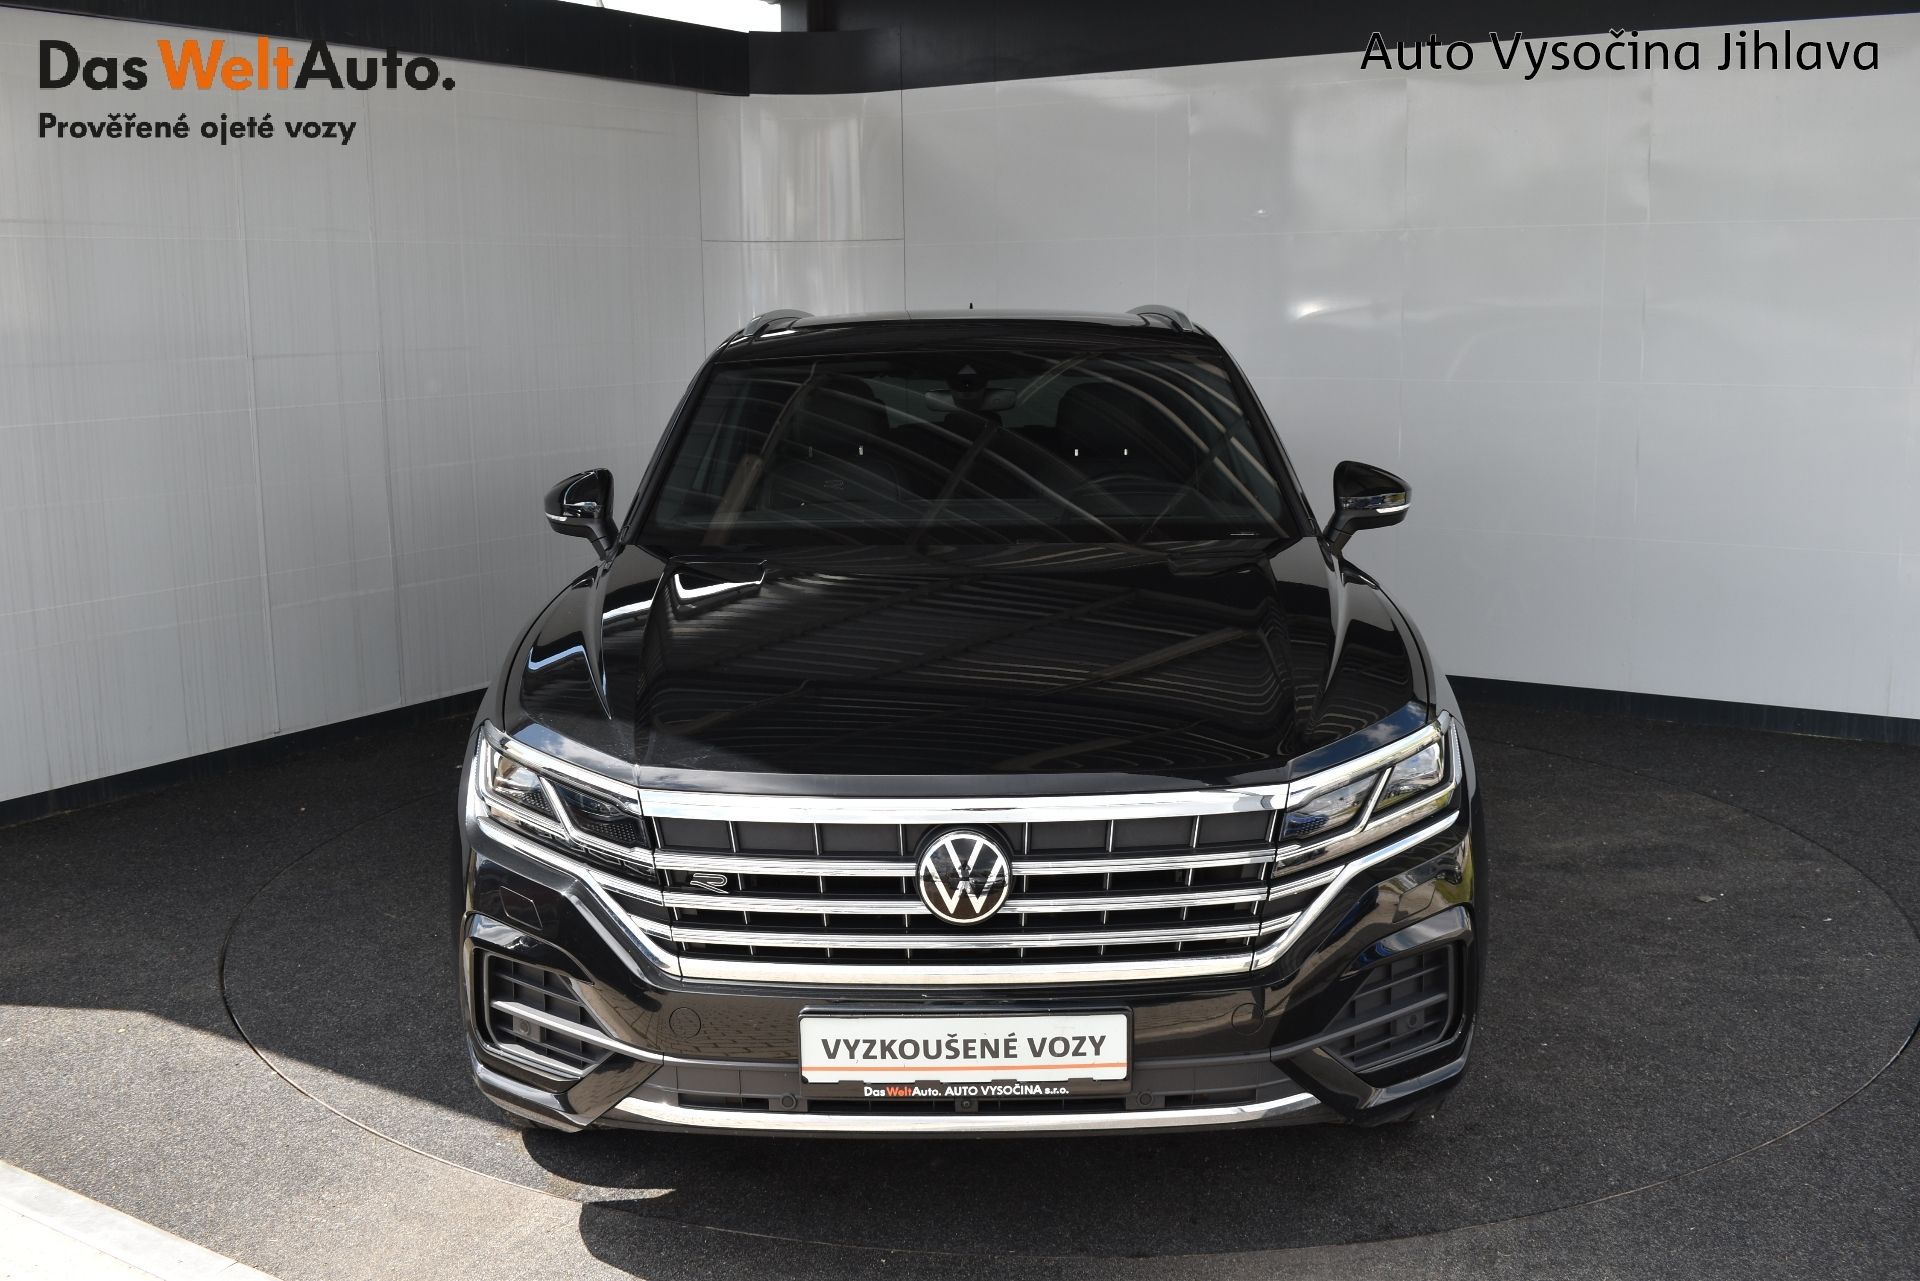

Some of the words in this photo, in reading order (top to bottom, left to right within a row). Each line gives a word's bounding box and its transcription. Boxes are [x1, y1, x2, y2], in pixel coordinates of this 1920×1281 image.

[821, 1032, 1018, 1060] VYZKOUŠENÉ
[1027, 1035, 1107, 1058] VOZY
[863, 1086, 886, 1097] Das
[944, 1086, 979, 1097] AUTO
[980, 1083, 1043, 1096] VYSOČINA
[1044, 1087, 1070, 1095] s.r.o.
